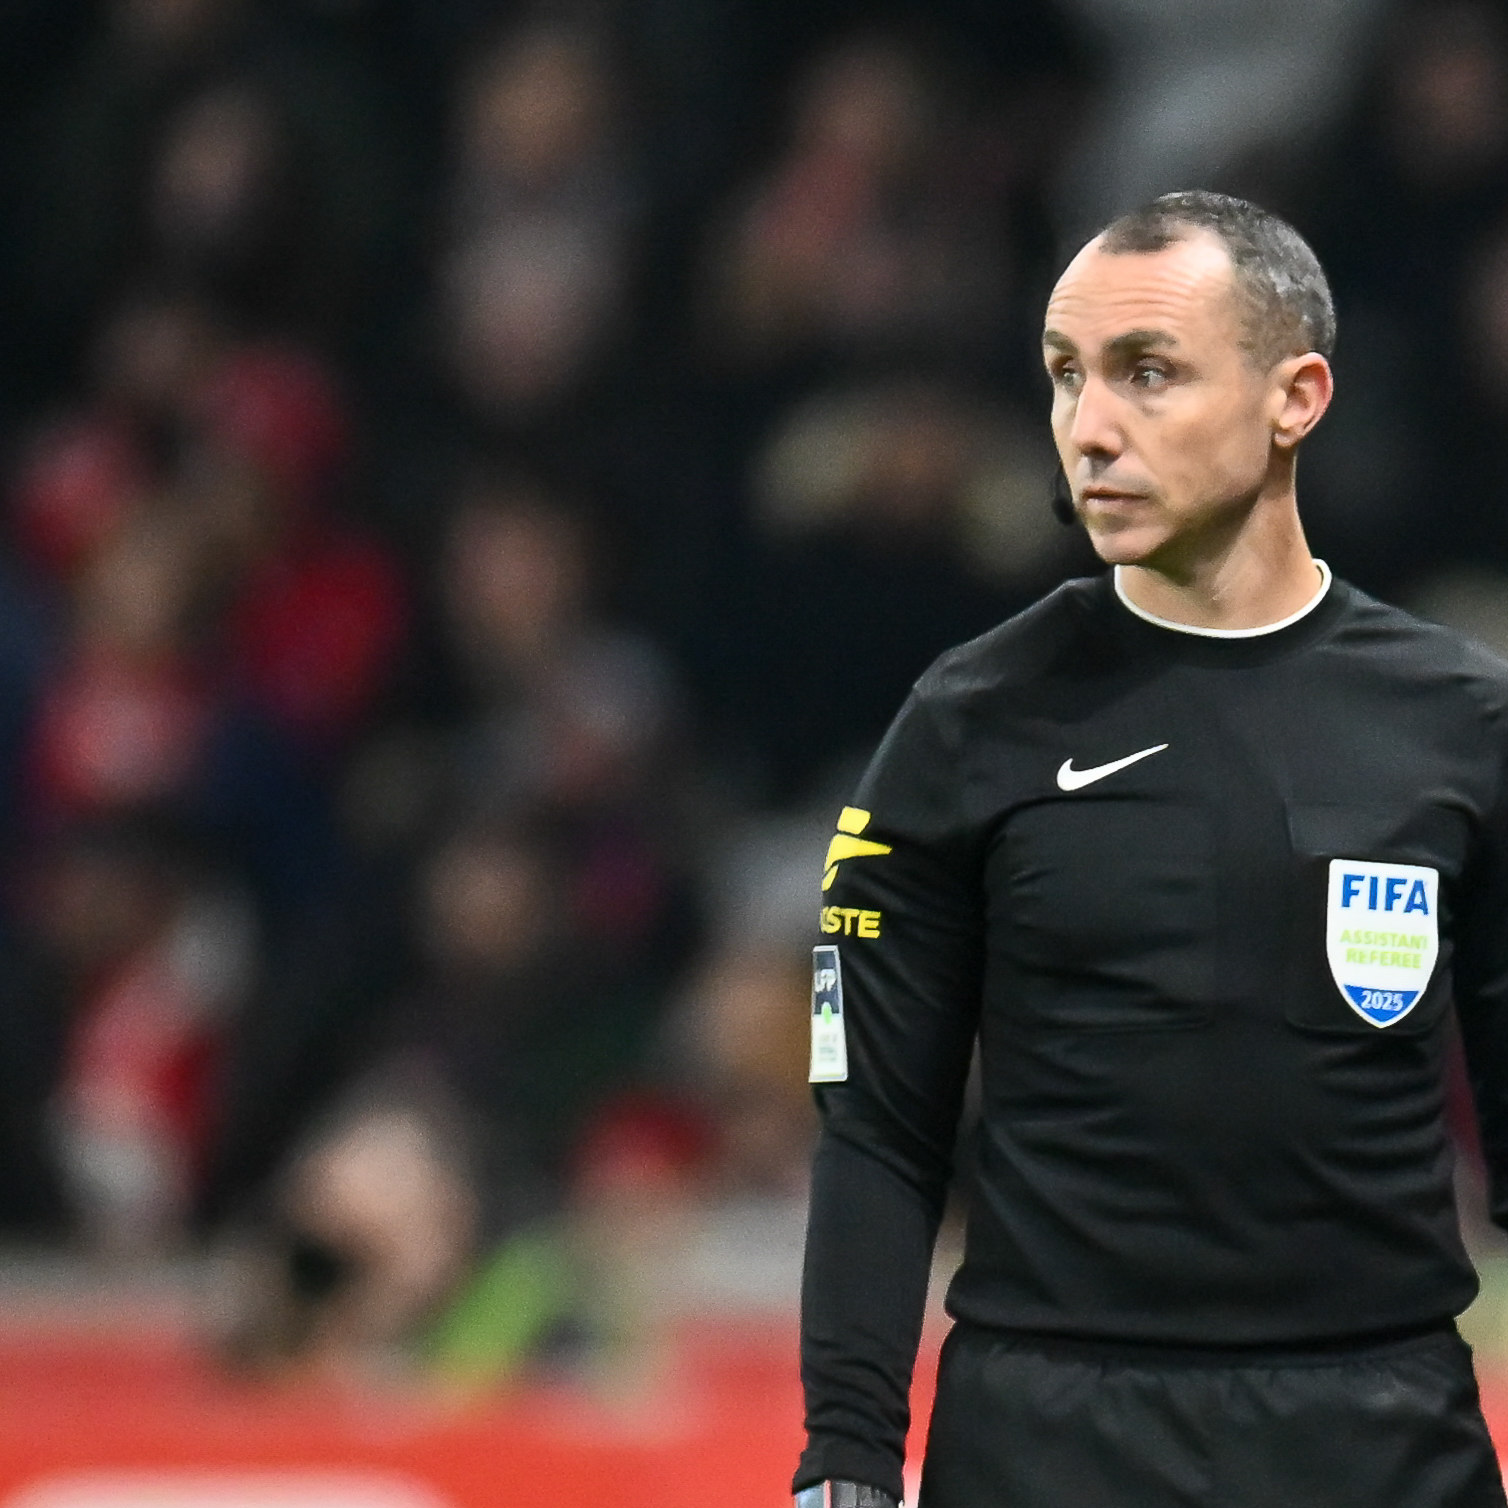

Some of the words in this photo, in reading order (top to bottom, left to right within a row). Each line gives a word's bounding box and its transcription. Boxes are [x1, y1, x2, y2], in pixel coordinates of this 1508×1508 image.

[1341, 873, 1429, 916] FIFA
[1339, 928, 1429, 950] ASSISTANT
[1345, 947, 1423, 969] REFEREE
[1361, 989, 1405, 1012] 2025
